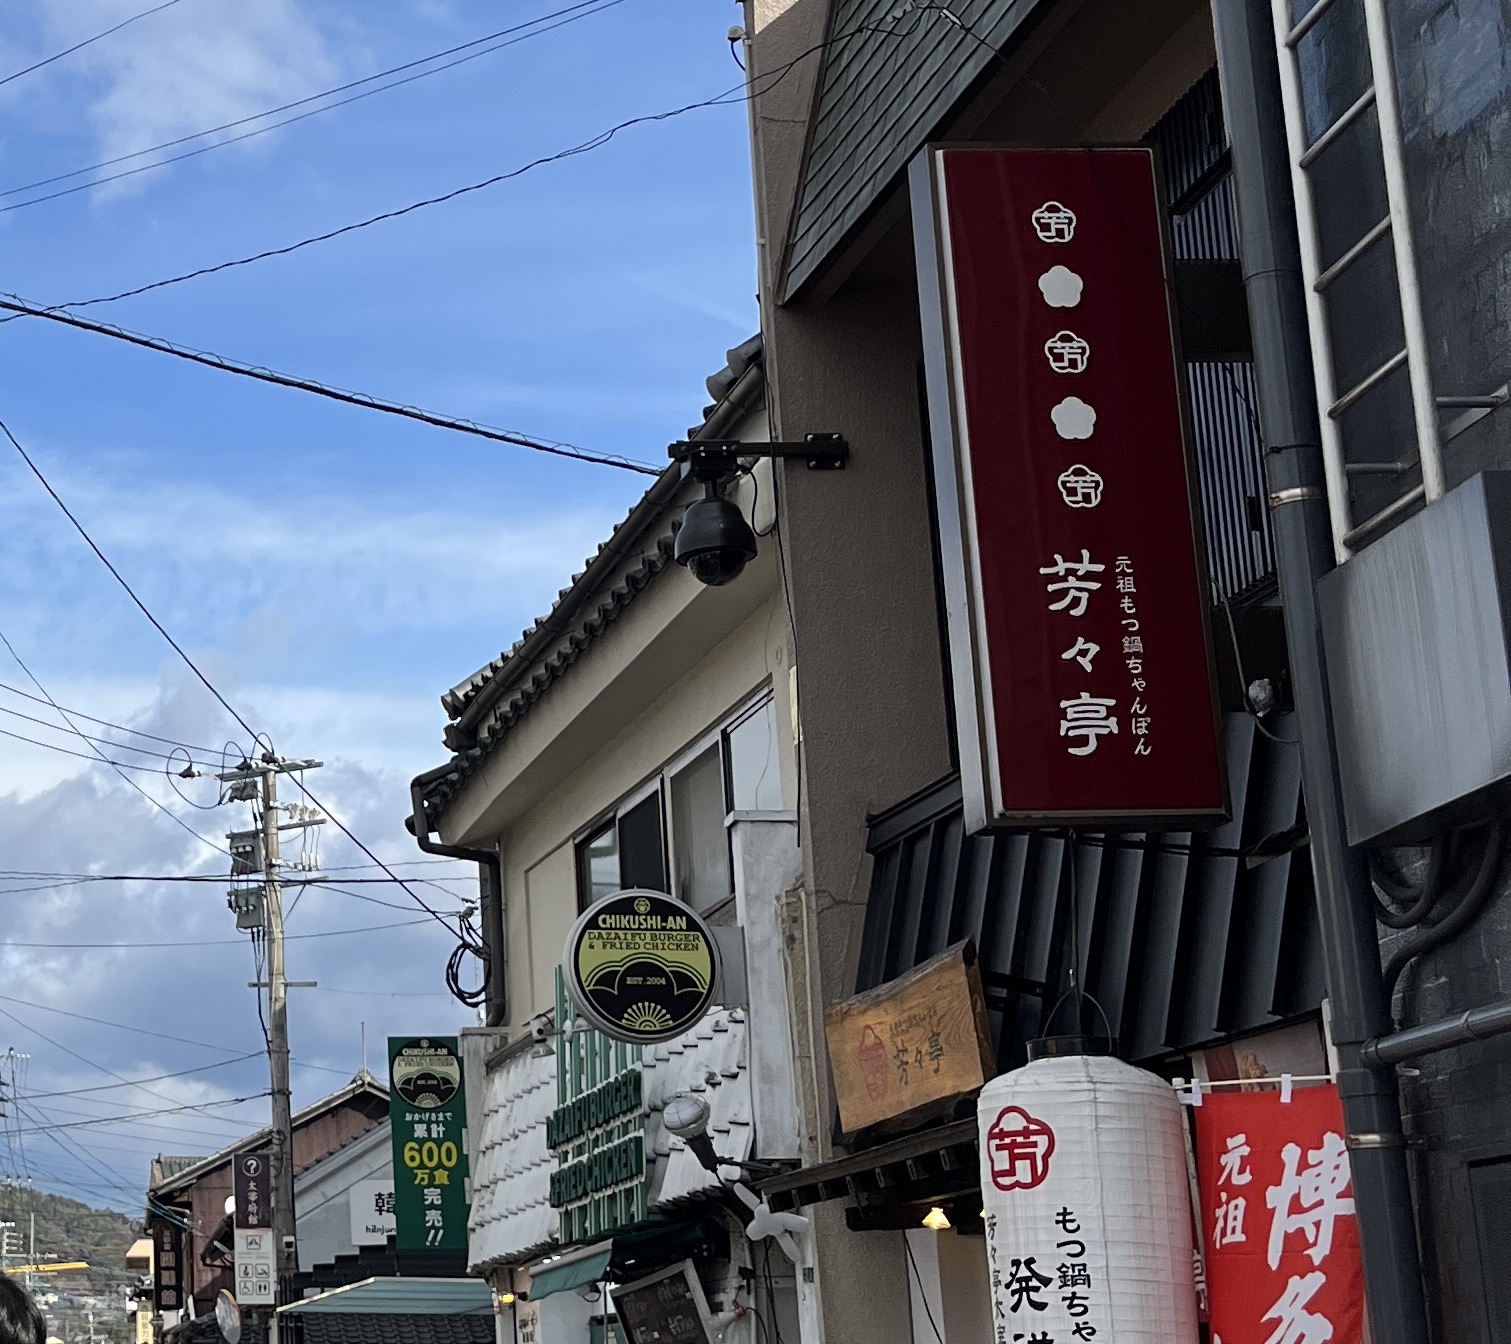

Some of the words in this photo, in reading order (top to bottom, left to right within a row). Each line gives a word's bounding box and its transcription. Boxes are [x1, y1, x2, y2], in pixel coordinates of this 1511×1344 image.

[1039, 549, 1118, 756] 芳々亭
[1115, 556, 1152, 755] 元祖もつ鍋ちゃんぽん
[598, 914, 687, 930] CHIKUSHI-AN
[588, 931, 646, 942] DAZAIFU
[650, 932, 701, 942] BURGER
[602, 942, 640, 950] FRIED
[643, 942, 699, 951] CHICKEN
[413, 1123, 445, 1138] 累計
[403, 1141, 458, 1168] 600
[414, 1169, 450, 1185] 万食
[1213, 1133, 1252, 1249] 元祖
